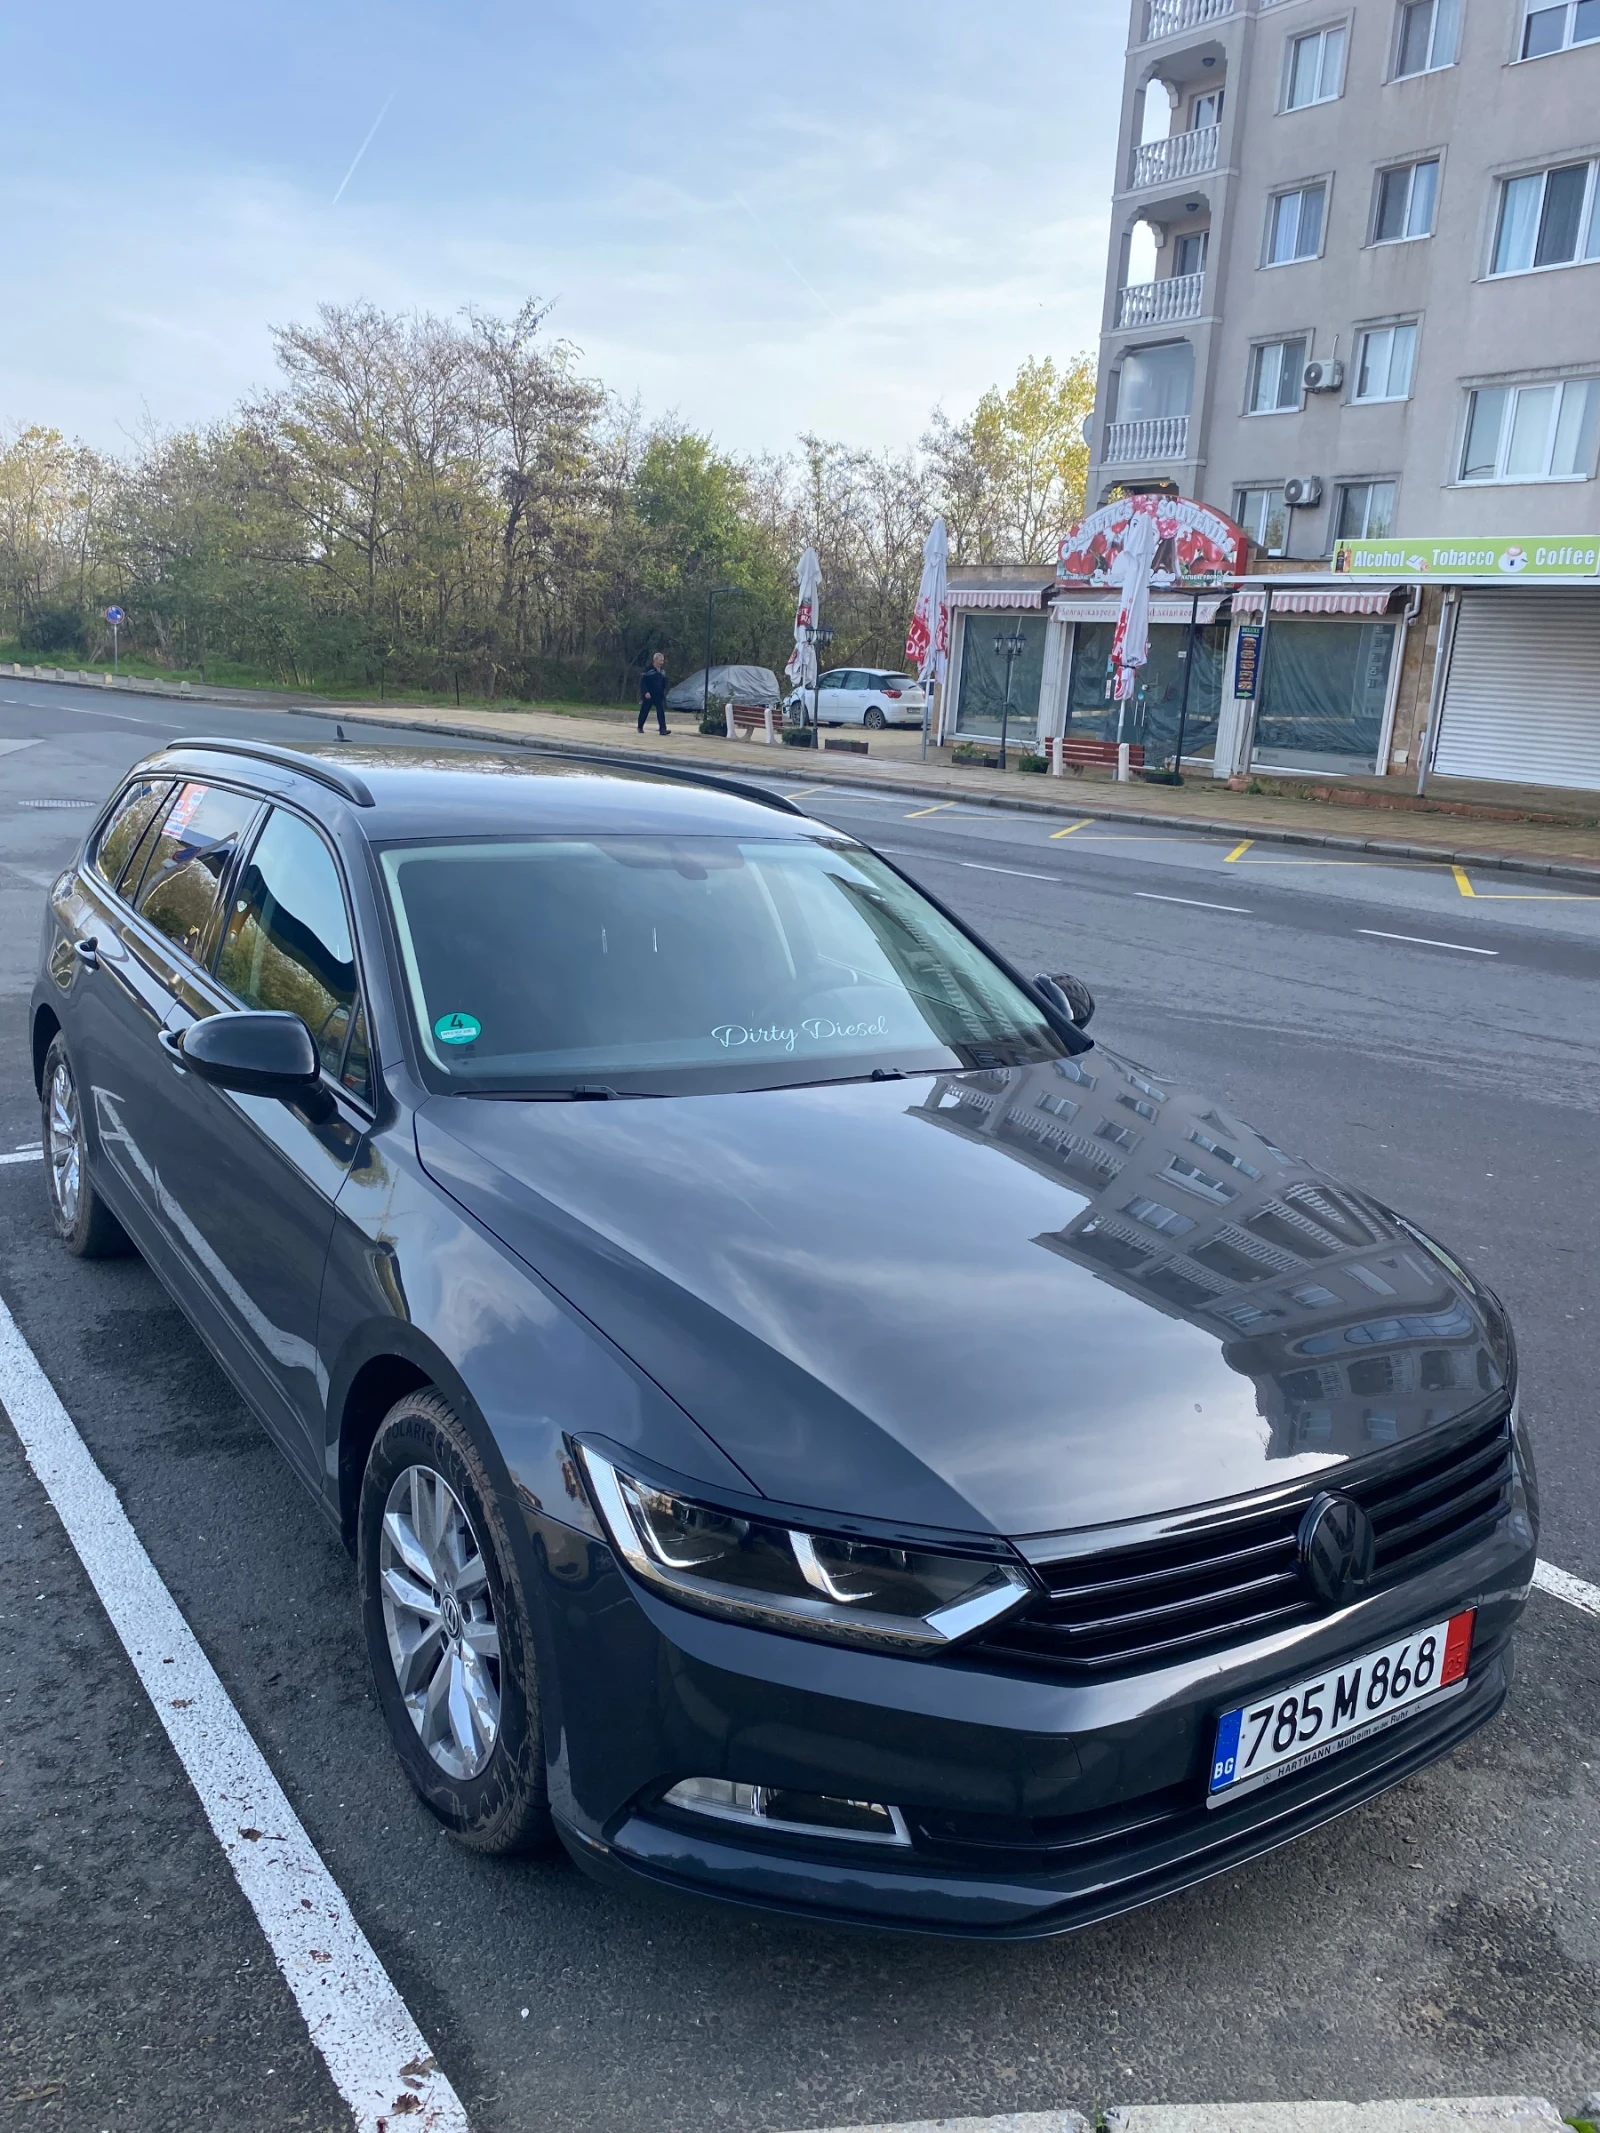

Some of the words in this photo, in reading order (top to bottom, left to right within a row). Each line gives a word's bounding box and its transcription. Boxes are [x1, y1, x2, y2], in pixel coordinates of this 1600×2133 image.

[1061, 502, 1134, 559] COSMETICS
[1156, 499, 1236, 554] SOUVENIRS
[1353, 550, 1405, 567] Alcohol
[1432, 548, 1494, 567] Tobacco
[1535, 546, 1596, 566] Coffee
[450, 1014, 464, 1028] 4
[711, 1024, 798, 1051] Dirty
[801, 1016, 888, 1039] Diesel
[386, 1421, 433, 1447] POLARIS
[1447, 1653, 1463, 1675] 25
[1244, 1683, 1325, 1768] 785
[1331, 1666, 1361, 1728] M
[1366, 1635, 1436, 1710] 868
[1277, 1745, 1331, 1777] HARTMANN
[1336, 1728, 1371, 1750] Mülheim
[1390, 1709, 1409, 1724] Ruhr
[1214, 1757, 1234, 1779] BG
